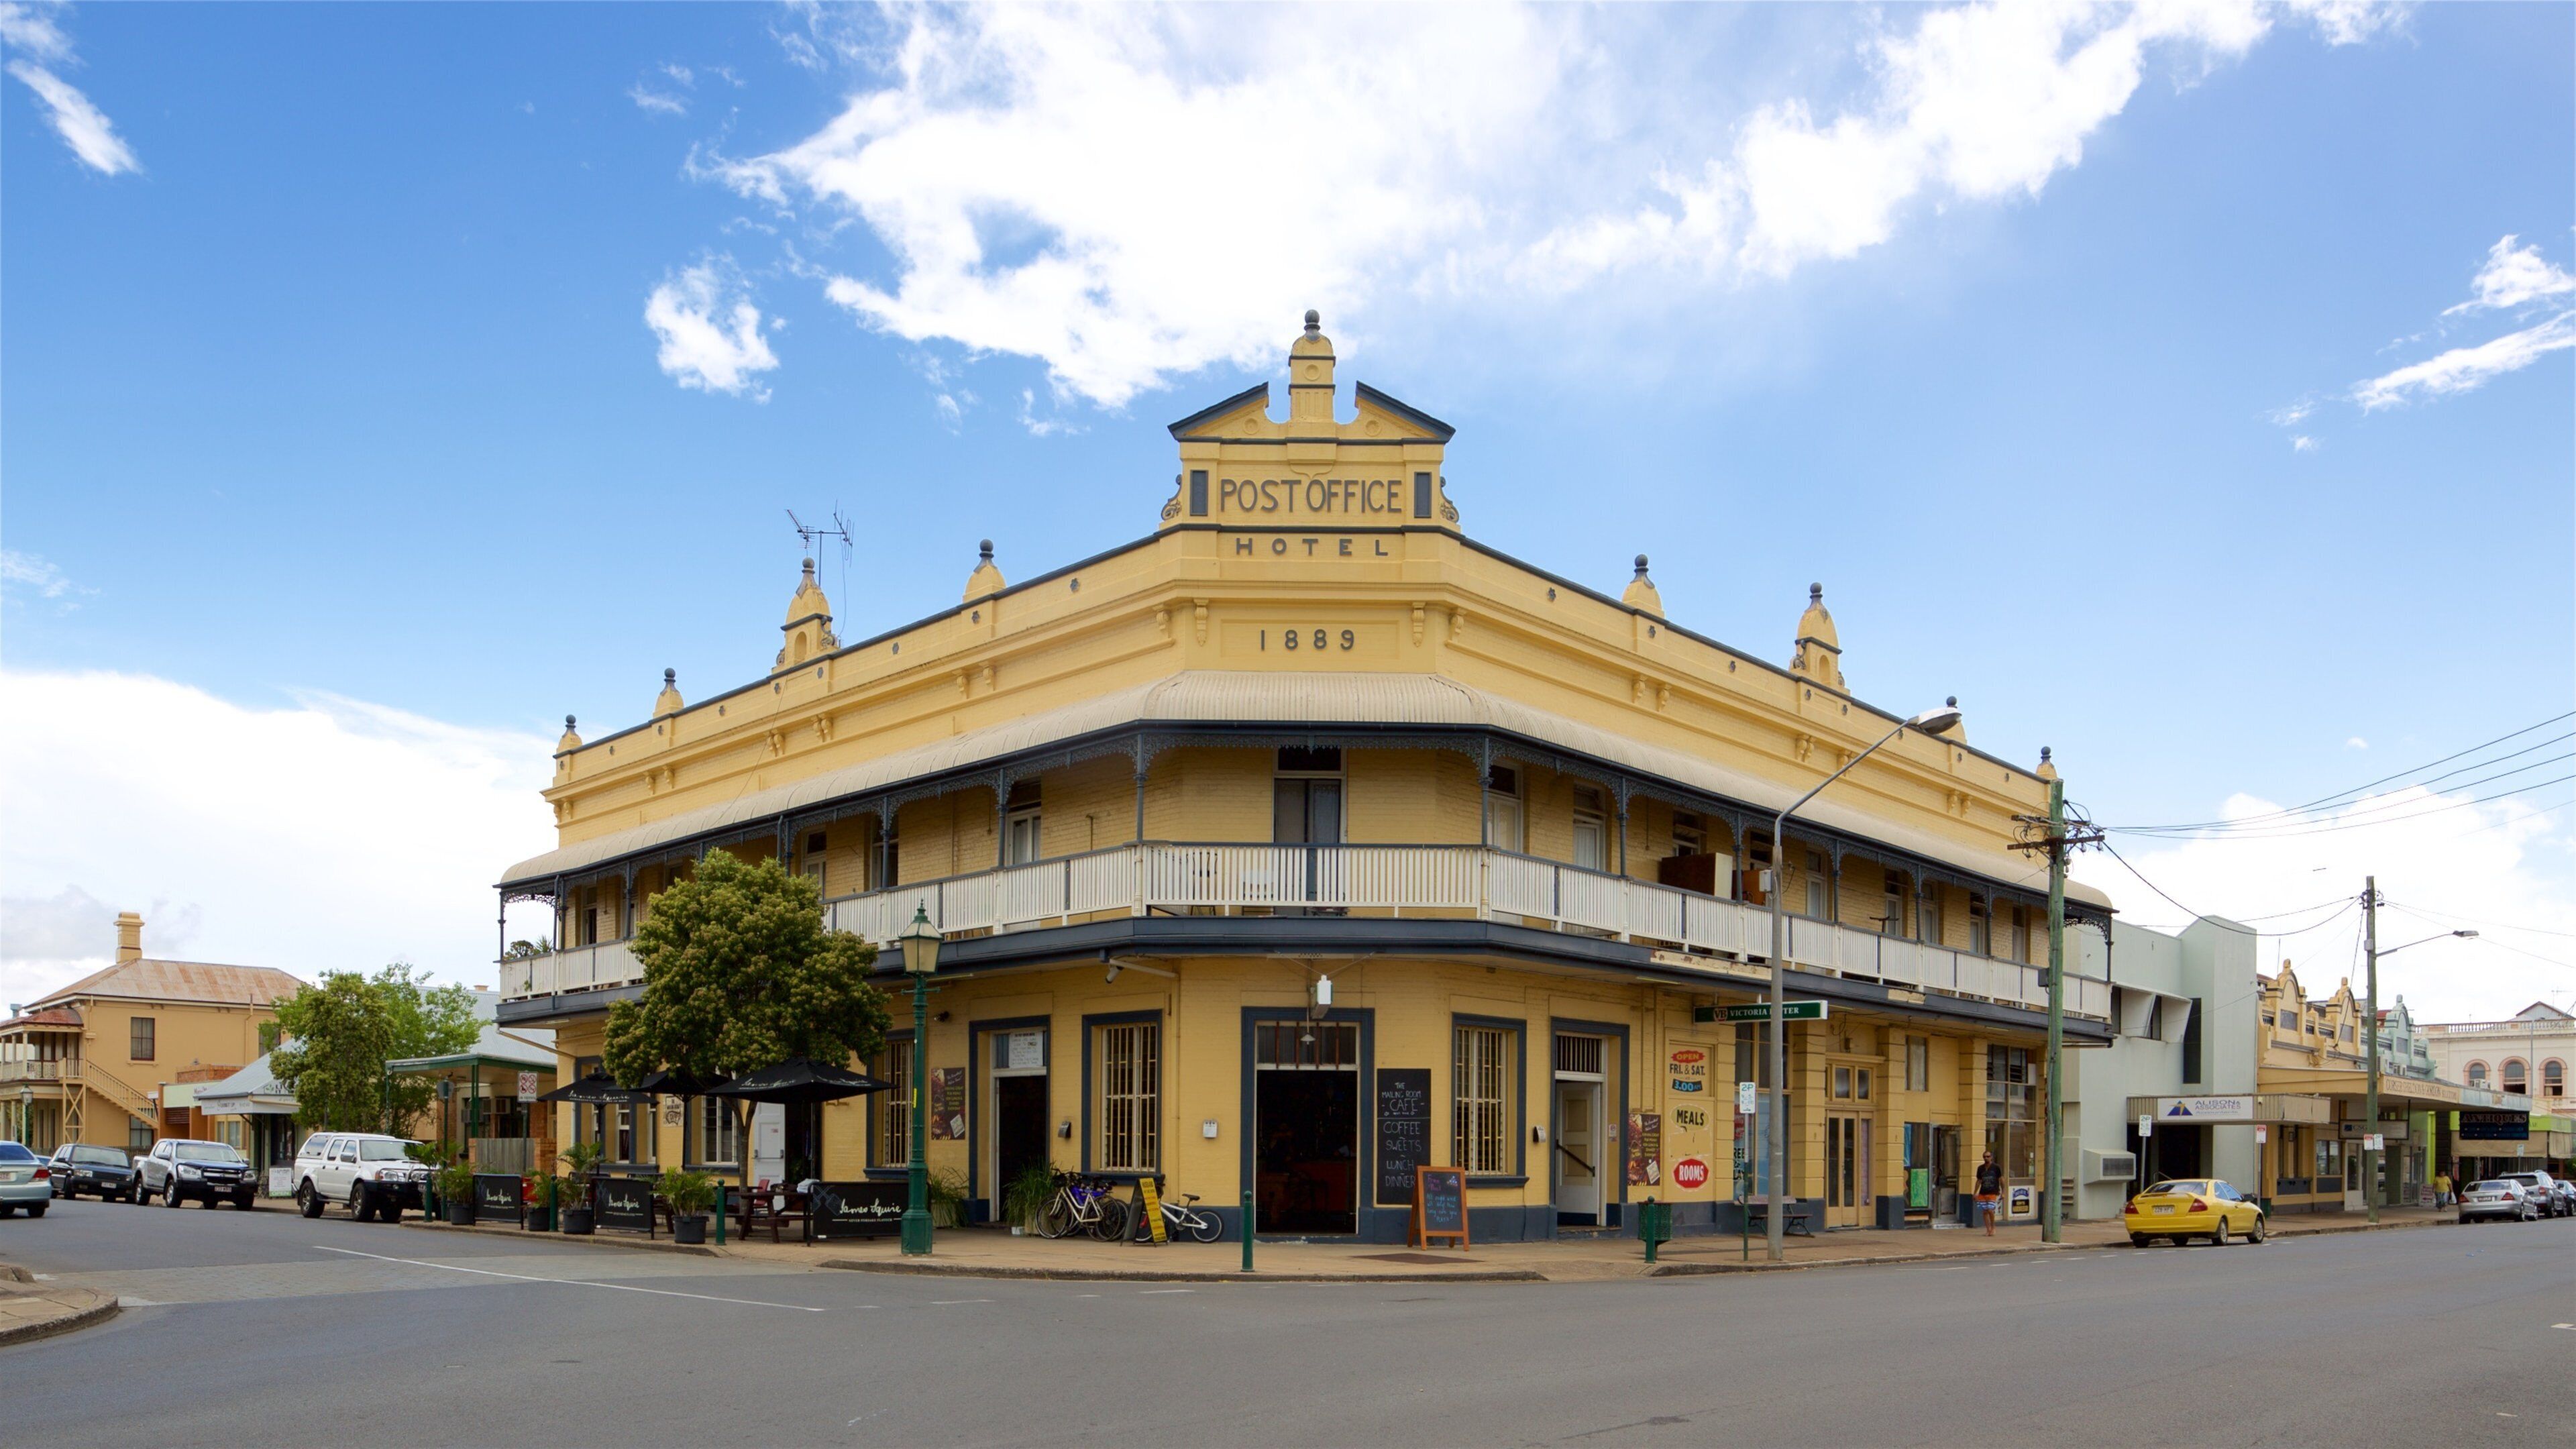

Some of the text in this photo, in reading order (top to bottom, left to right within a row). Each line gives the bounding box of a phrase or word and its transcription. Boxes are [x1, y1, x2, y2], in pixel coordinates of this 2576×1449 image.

[1221, 479, 1402, 513] POST OFFICE
[1236, 538, 1388, 556] HOTEL
[1261, 629, 1354, 651] 1889
[1715, 1010, 1727, 1018] VB
[1730, 1008, 1767, 1016] VICTORIA
[1670, 1064, 1705, 1075] FRI. & SAT.
[1405, 1090, 1421, 1098] ROOM
[1677, 1110, 1704, 1126] MEALS
[2463, 1114, 2526, 1126] ANTIQUES
[1383, 1122, 1421, 1134] COFFEE
[1386, 1140, 1421, 1152] SWEETS
[1386, 1159, 1415, 1170] LUNCH
[1679, 1165, 1704, 1181] ROOMS
[1385, 1175, 1415, 1187] DINNER
[840, 1198, 901, 1216] James Squire
